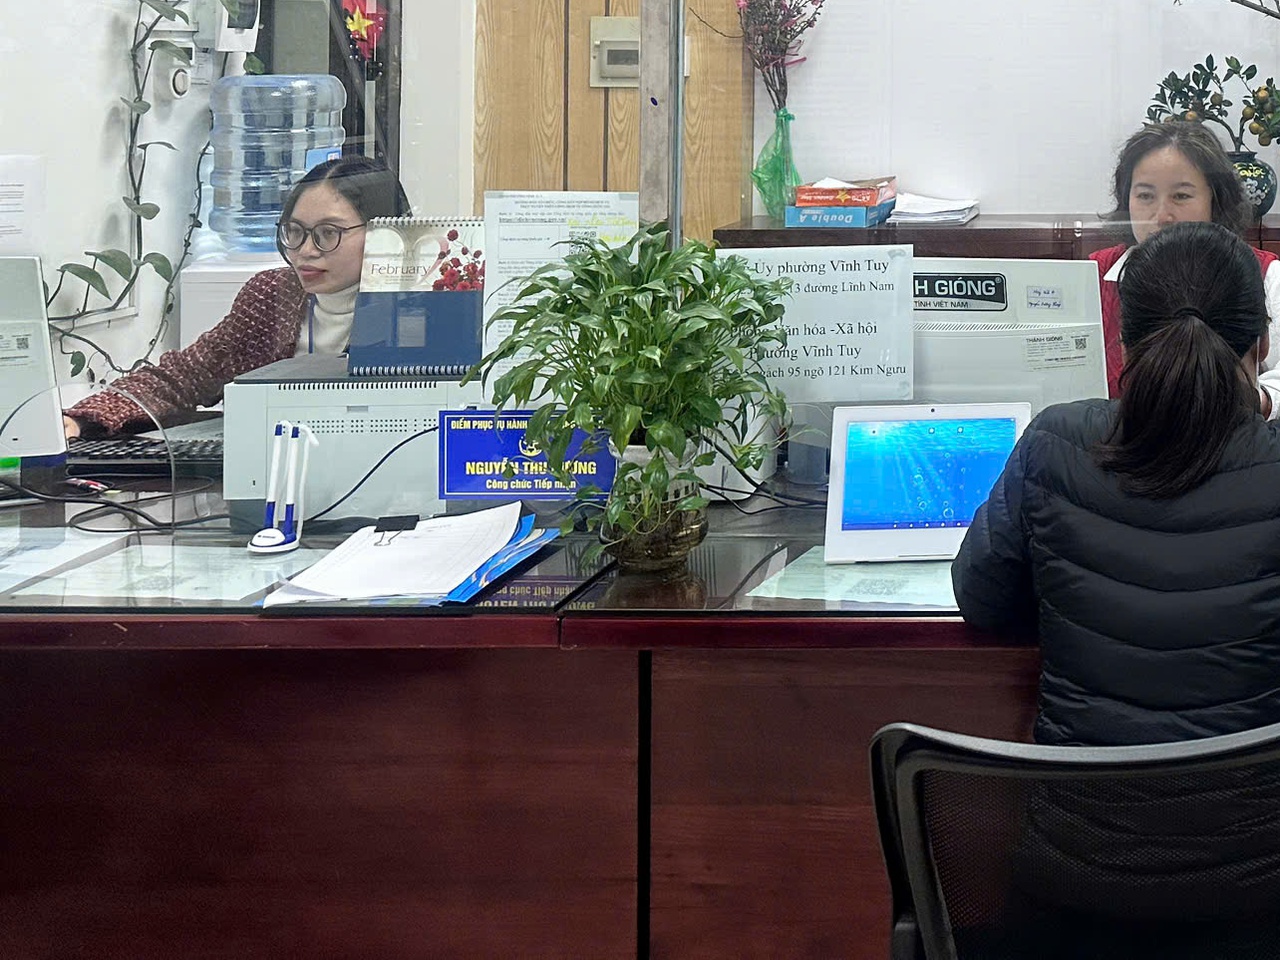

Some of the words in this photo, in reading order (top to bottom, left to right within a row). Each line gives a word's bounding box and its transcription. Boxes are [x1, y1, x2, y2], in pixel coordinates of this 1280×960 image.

[811, 214, 853, 224] Double
[371, 263, 431, 276] February
[777, 260, 826, 276] phường
[830, 259, 861, 272] Vĩnh
[864, 259, 889, 274] Tuy
[841, 281, 866, 293] Lĩnh
[869, 281, 894, 292] Nam
[934, 276, 996, 296] GIÓNG
[803, 324, 826, 336] hóa
[857, 321, 878, 336] hội
[802, 344, 834, 358] Vĩnh
[837, 344, 862, 359] Tuy
[787, 366, 801, 378] 95
[827, 365, 846, 377] 121
[849, 364, 873, 376] Kim
[876, 363, 907, 377] Ngưu
[472, 419, 493, 431] PHỤC
[486, 479, 508, 490] Công
[510, 478, 532, 489] chức
[534, 477, 552, 490] Tiếp
[554, 479, 576, 490] nn
